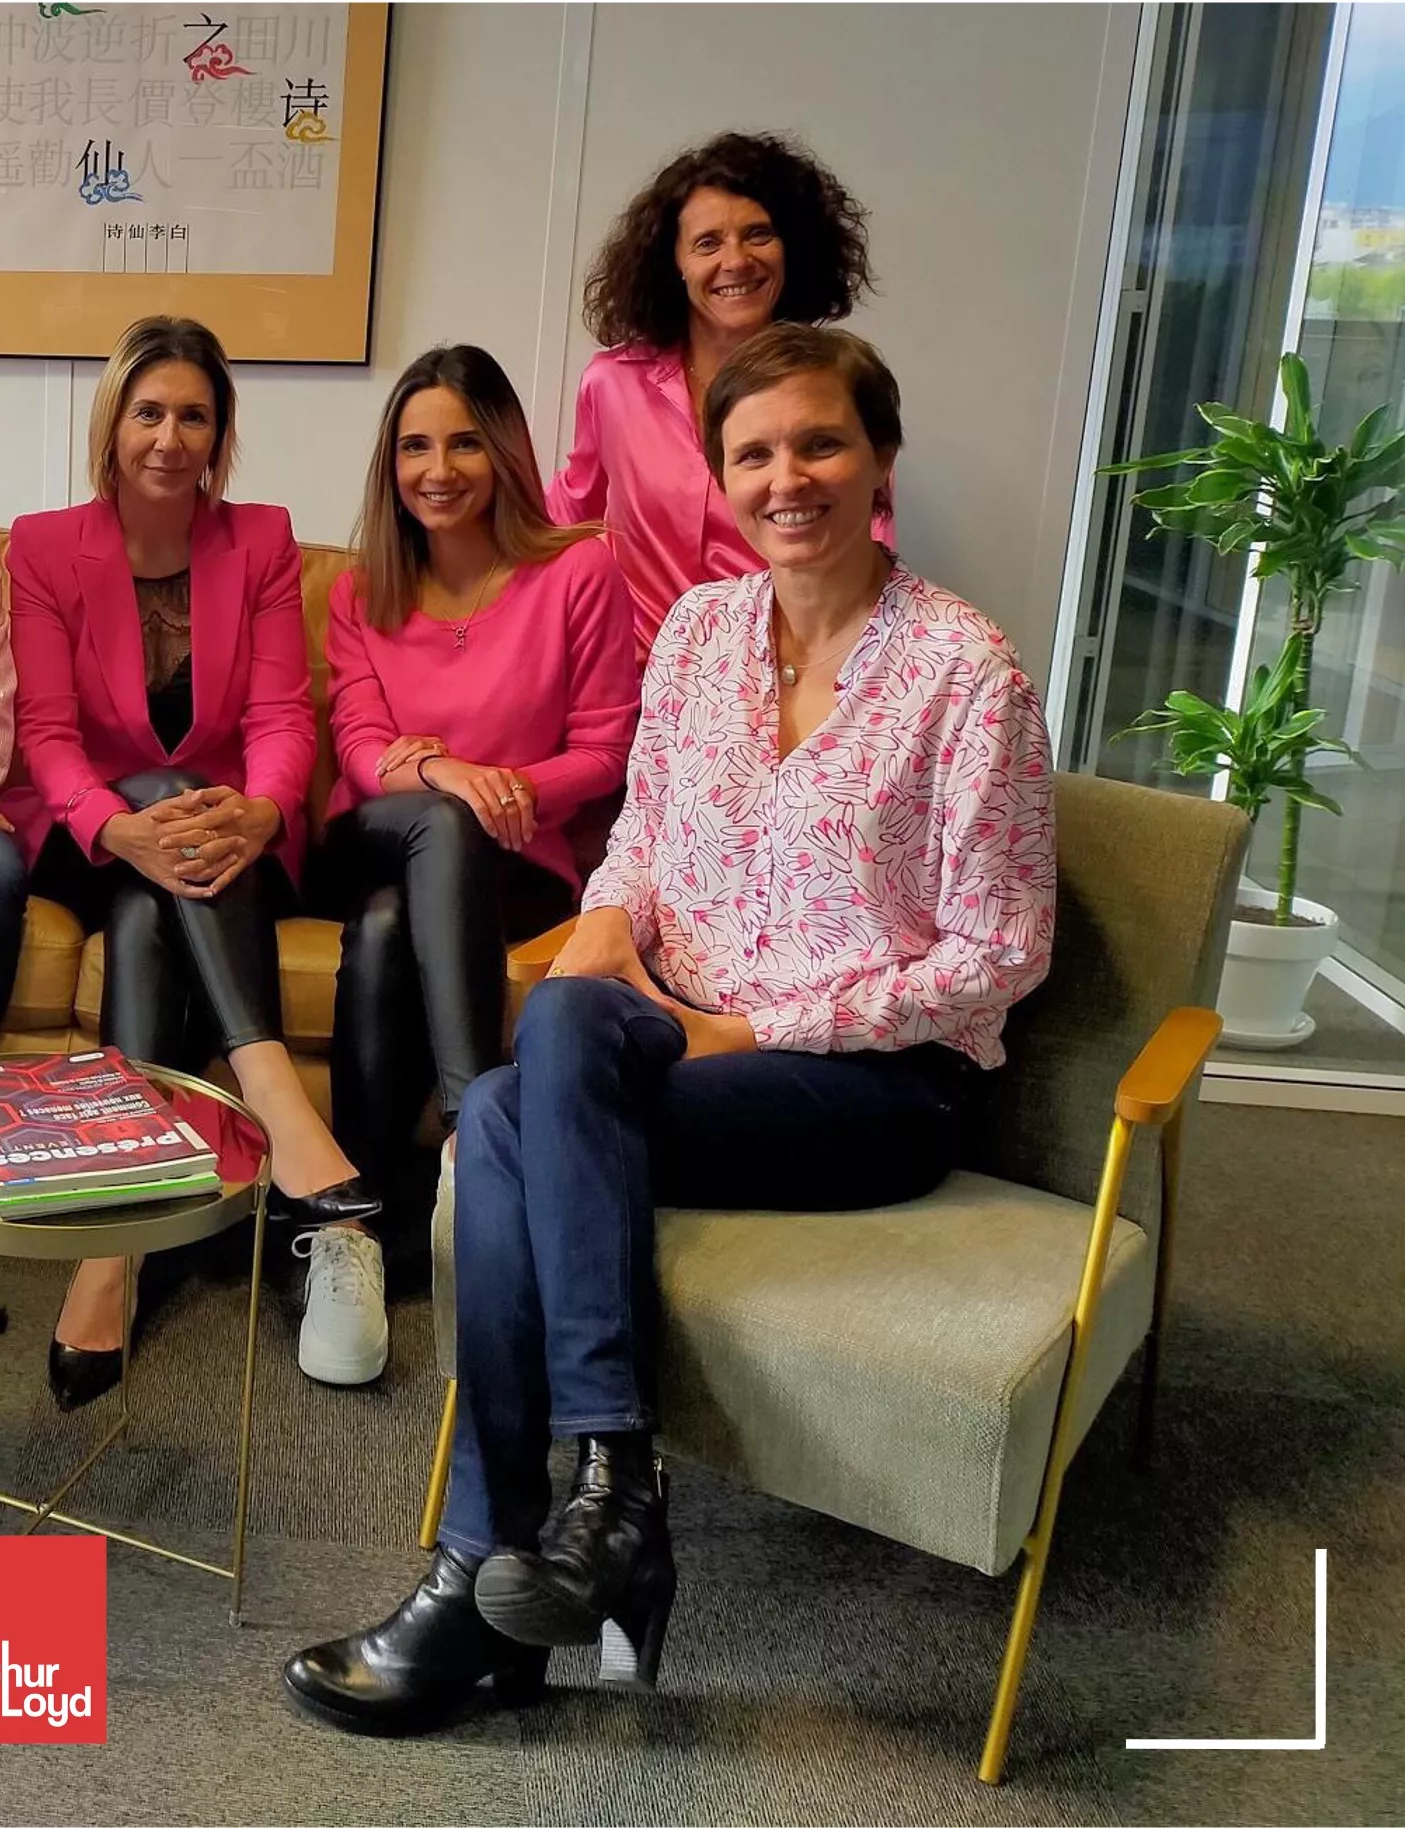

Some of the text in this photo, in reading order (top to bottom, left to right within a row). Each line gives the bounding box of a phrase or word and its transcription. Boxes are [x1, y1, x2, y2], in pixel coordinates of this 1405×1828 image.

[107, 223, 187, 240] 诗仙李白
[73, 1097, 122, 1110] nouvelles
[122, 1093, 144, 1102] aux
[27, 1103, 73, 1116] menaces
[79, 1108, 100, 1118] agir
[101, 1100, 151, 1114] Comment
[53, 1112, 78, 1120] face
[14, 1140, 70, 1152] EVENT
